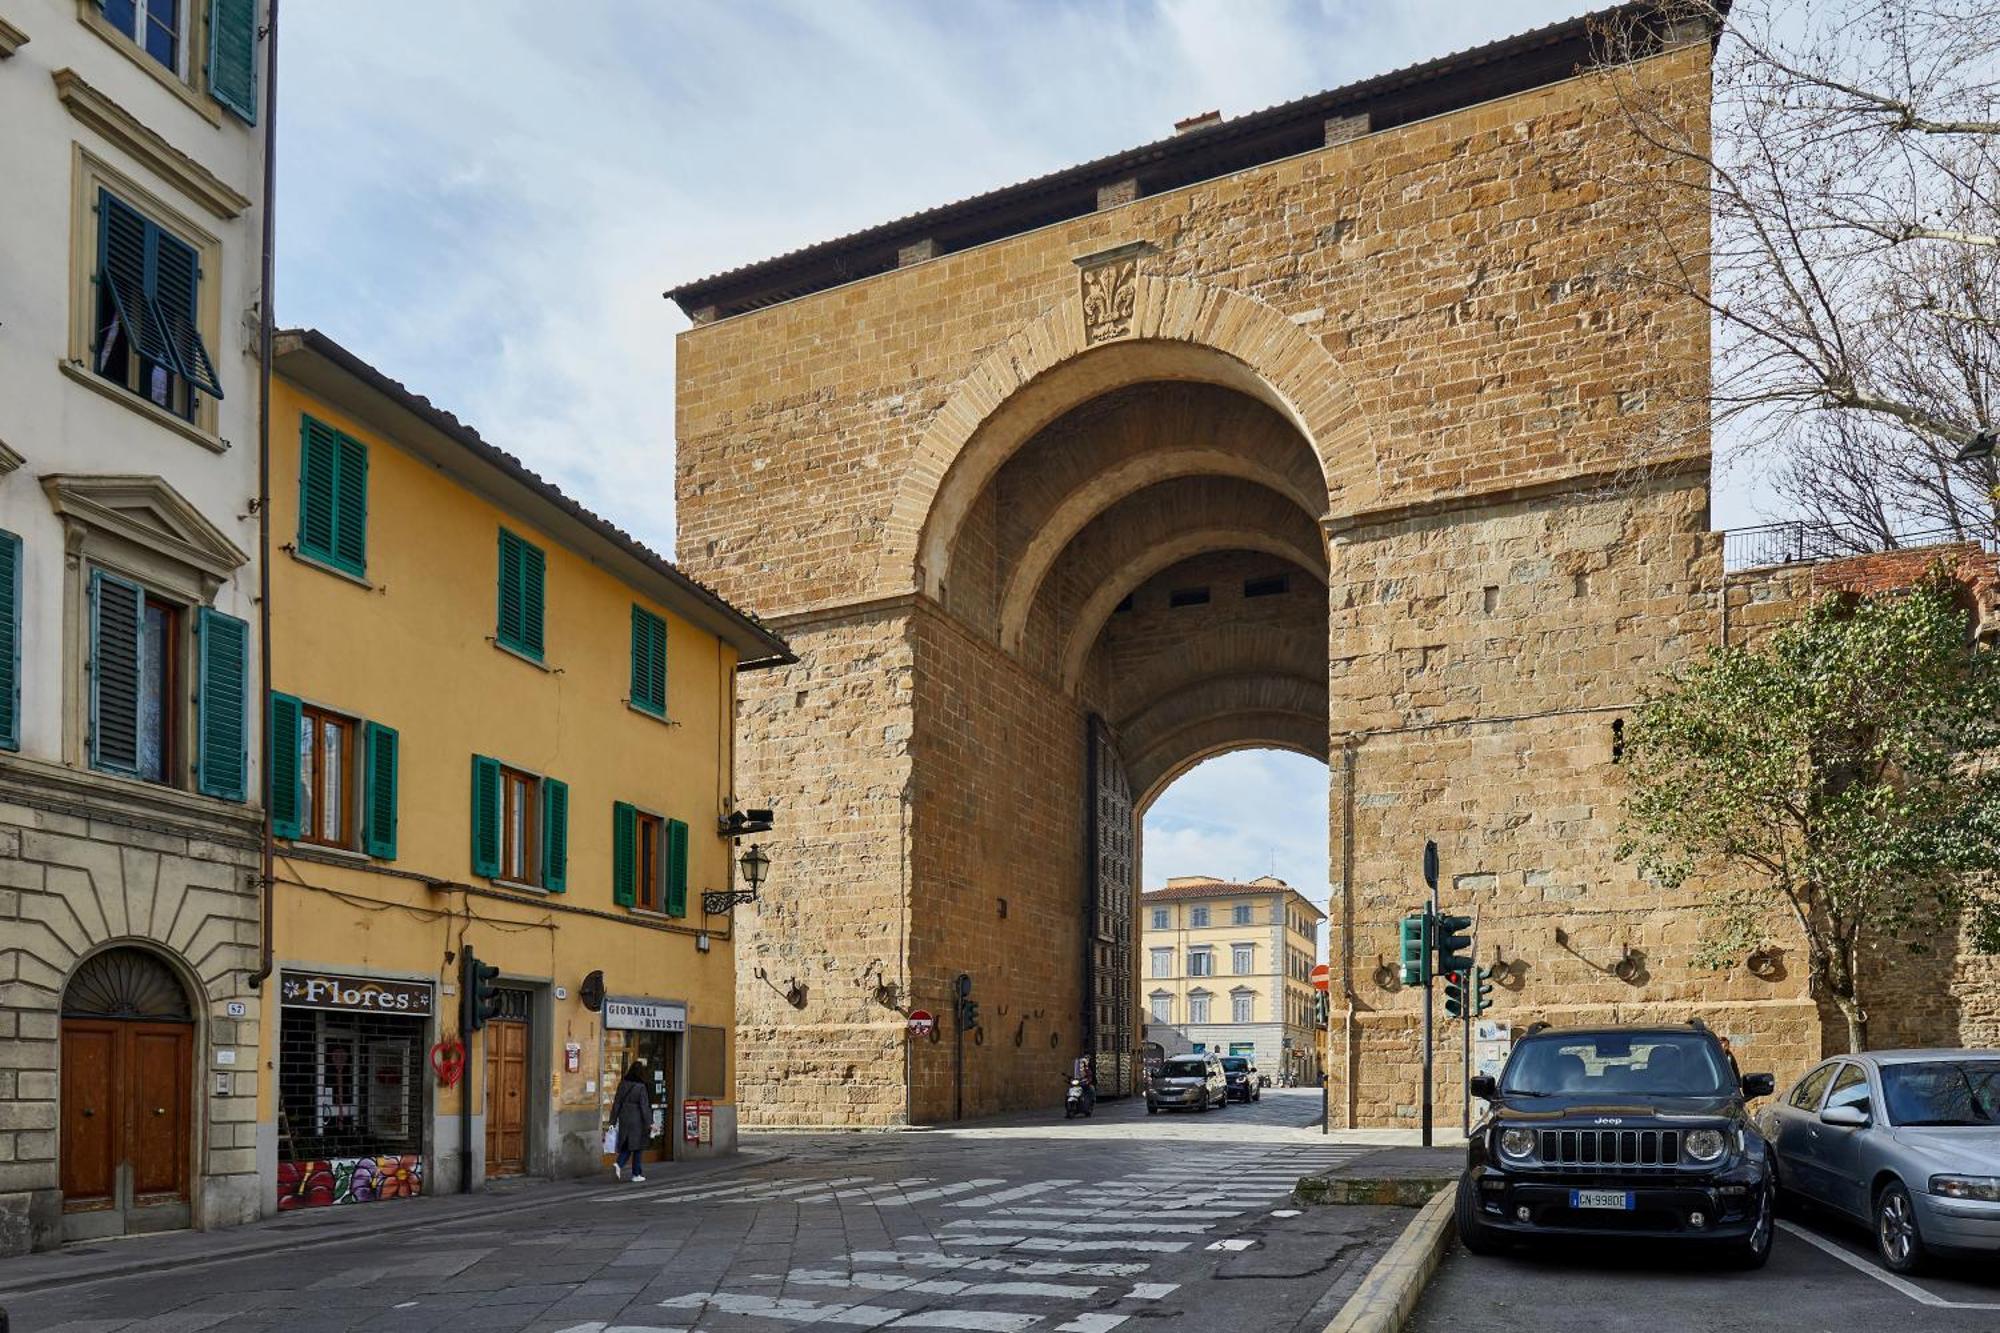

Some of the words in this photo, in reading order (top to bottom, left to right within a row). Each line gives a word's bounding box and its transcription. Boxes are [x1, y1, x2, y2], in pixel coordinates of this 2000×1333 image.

[306, 979, 409, 1009] Flores
[609, 1004, 657, 1017] GIORNALI
[645, 1018, 685, 1030] RIVISTE
[1594, 1117, 1622, 1125] Jeep
